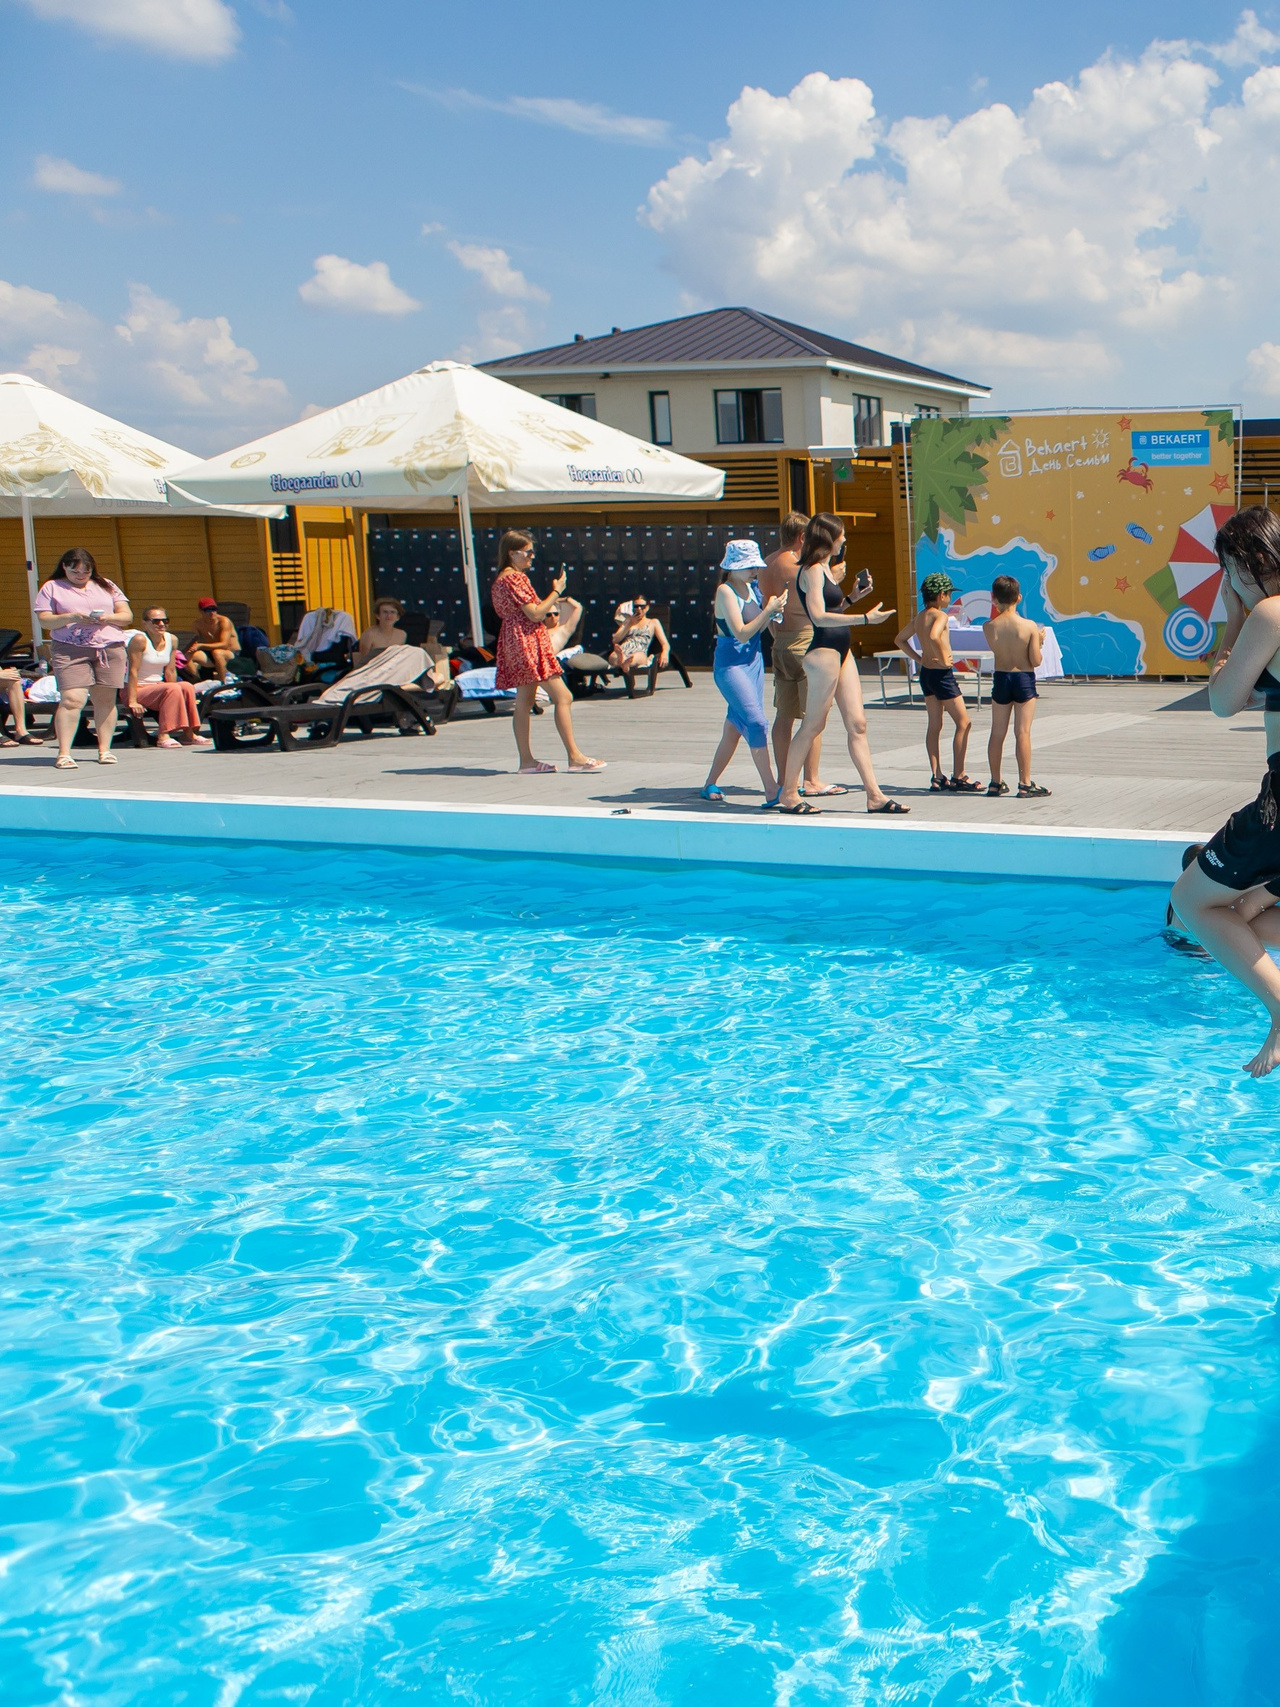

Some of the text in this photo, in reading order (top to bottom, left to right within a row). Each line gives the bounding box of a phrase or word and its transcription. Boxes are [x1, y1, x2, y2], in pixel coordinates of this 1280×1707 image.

[1025, 435, 1088, 458] Bekaert
[1151, 434, 1202, 445] BEKAERT
[1028, 453, 1110, 477] День Семьи
[1151, 451, 1203, 461] better together
[270, 470, 338, 494] Hoegaarden
[567, 463, 625, 486] Hoegaarden
